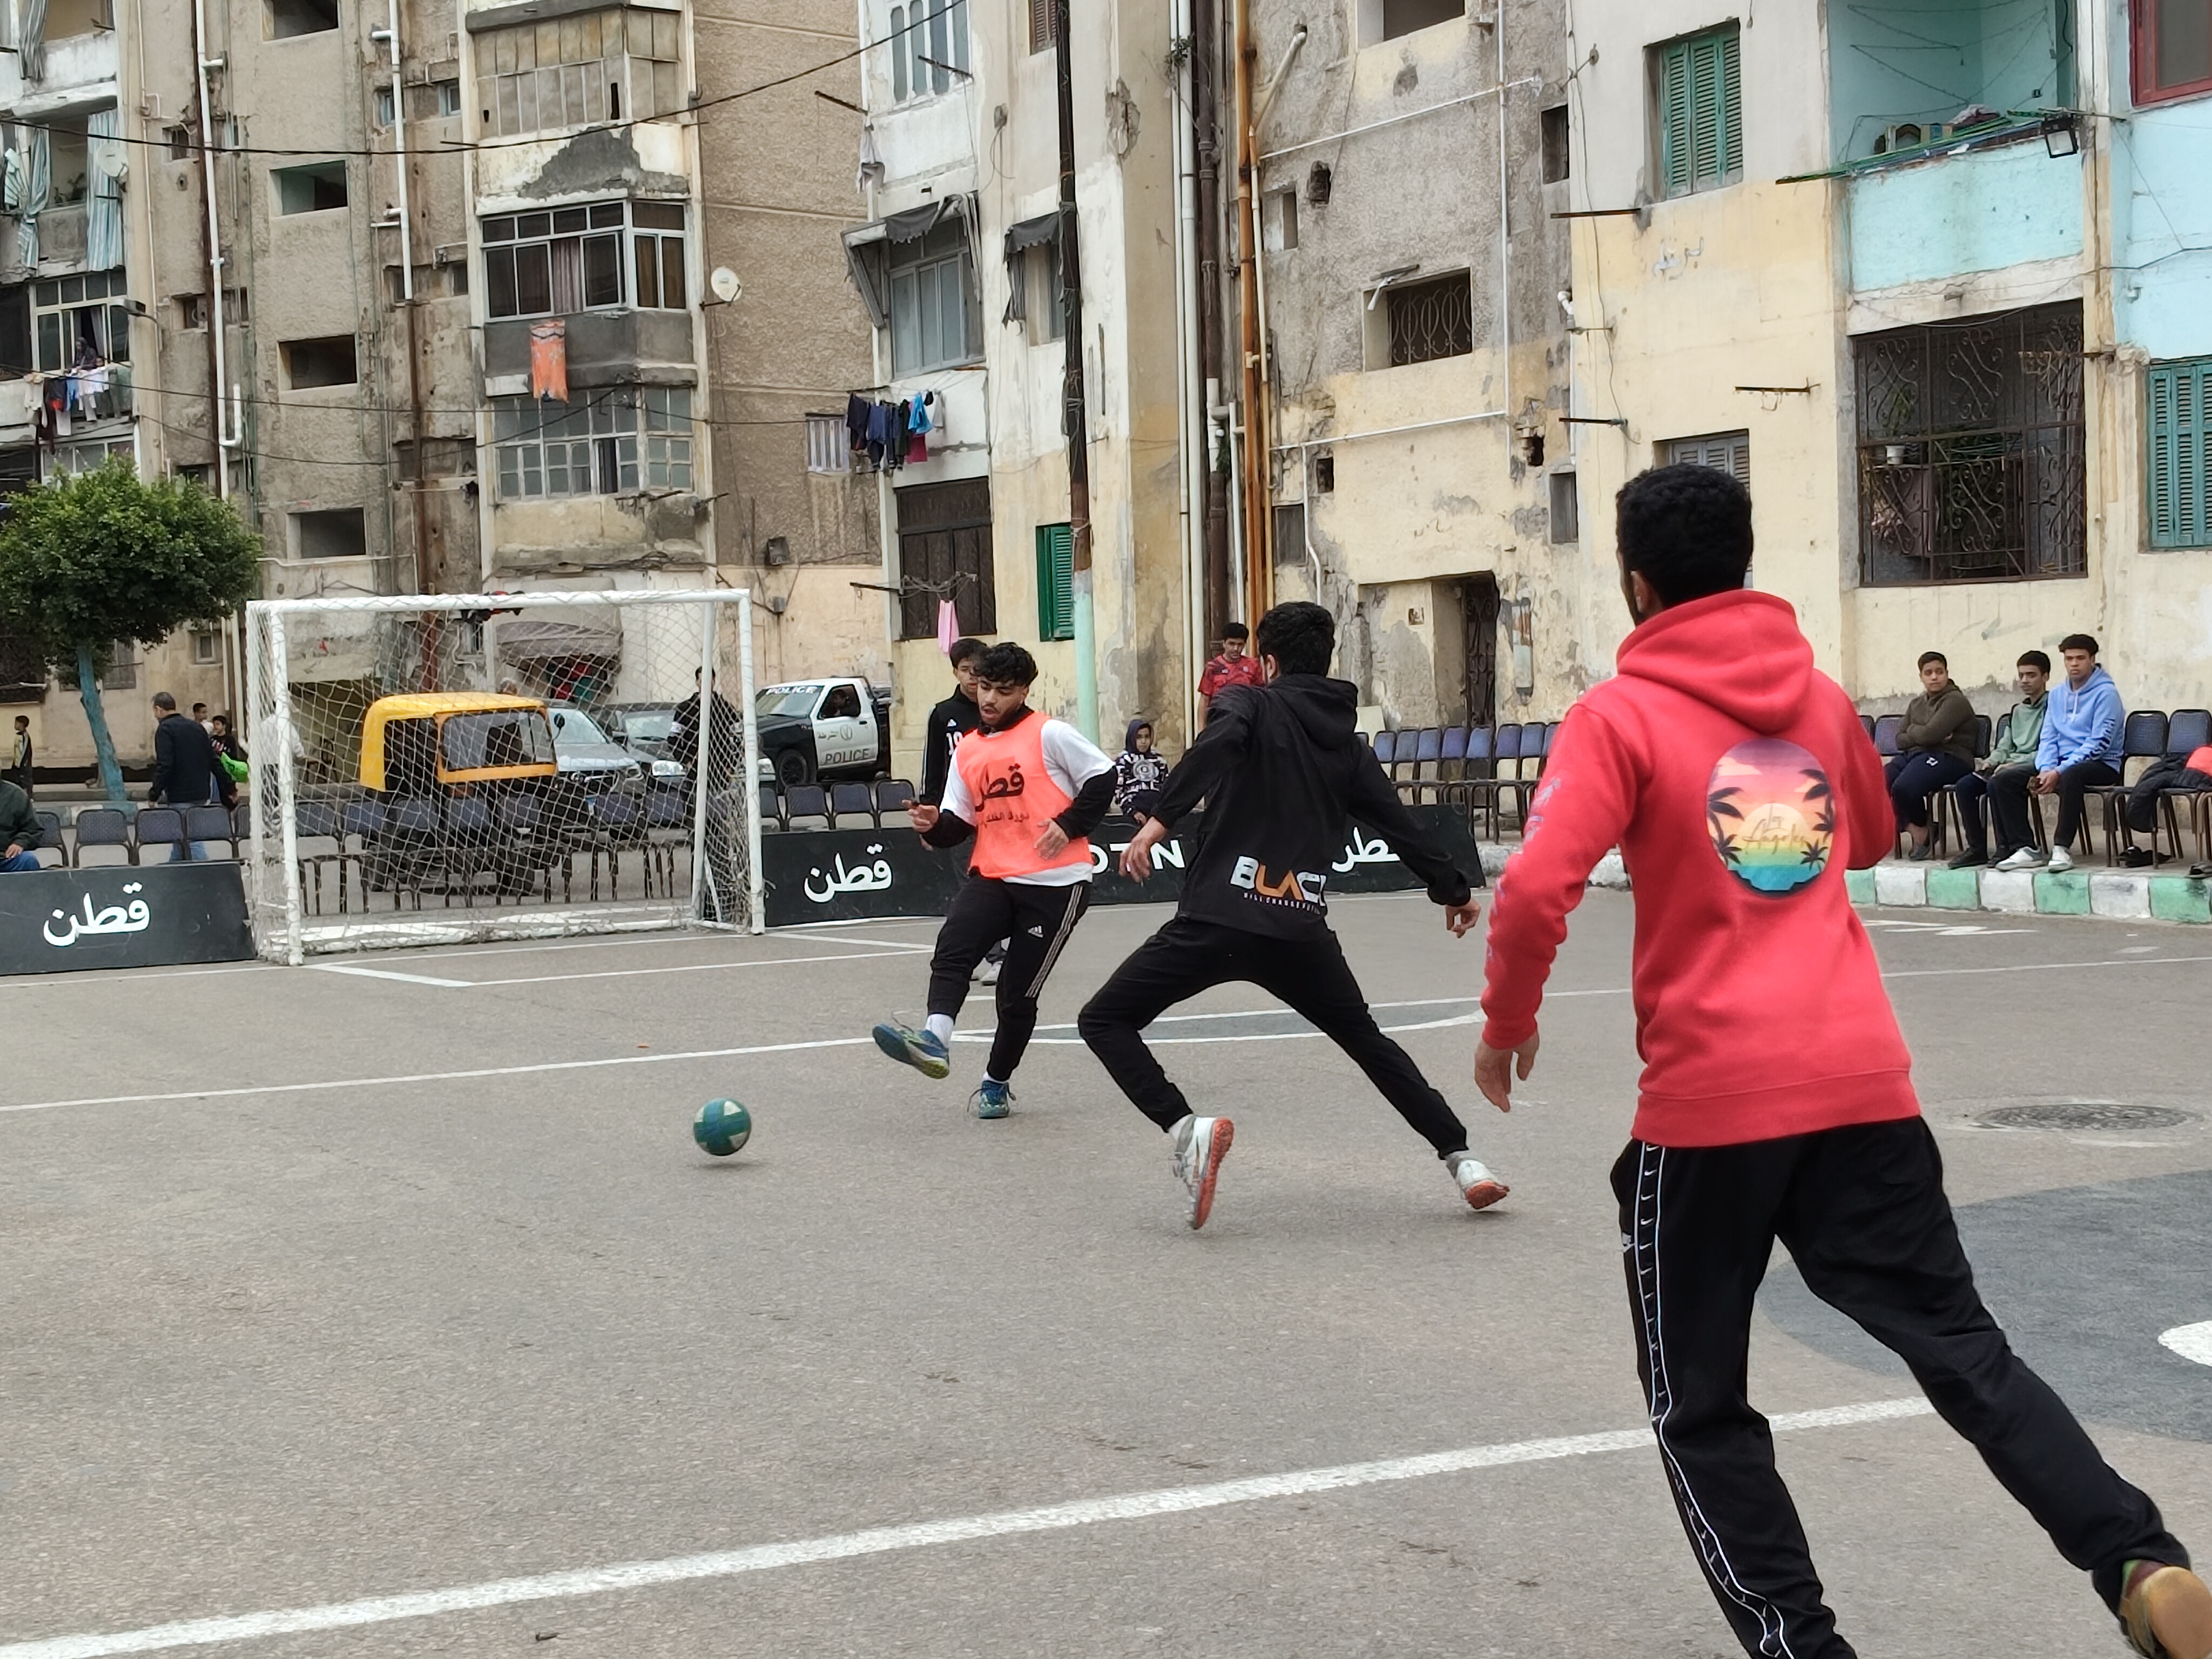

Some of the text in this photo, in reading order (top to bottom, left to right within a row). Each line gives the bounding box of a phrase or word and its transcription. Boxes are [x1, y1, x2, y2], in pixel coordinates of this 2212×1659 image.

[766, 686, 818, 695] POLICE
[825, 748, 871, 765] POLICE
[804, 843, 892, 903] قطن
[43, 881, 150, 947] قطن
